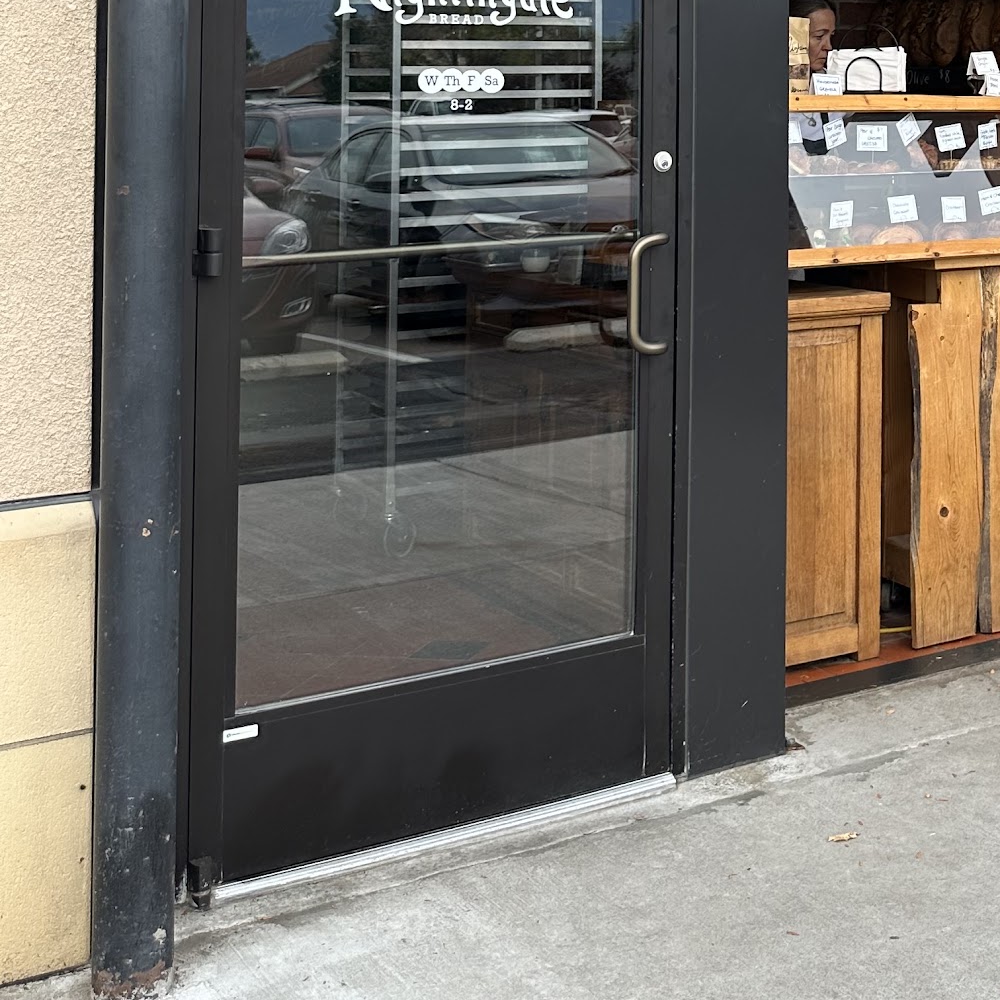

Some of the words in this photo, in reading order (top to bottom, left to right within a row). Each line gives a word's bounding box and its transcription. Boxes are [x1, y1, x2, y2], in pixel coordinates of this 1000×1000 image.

[428, 13, 485, 26] BREAD
[424, 75, 439, 87] W
[444, 75, 460, 87] Th
[467, 75, 476, 87] F
[484, 75, 499, 87] Sa
[907, 69, 929, 85] Olive
[450, 99, 474, 111] 8-2
